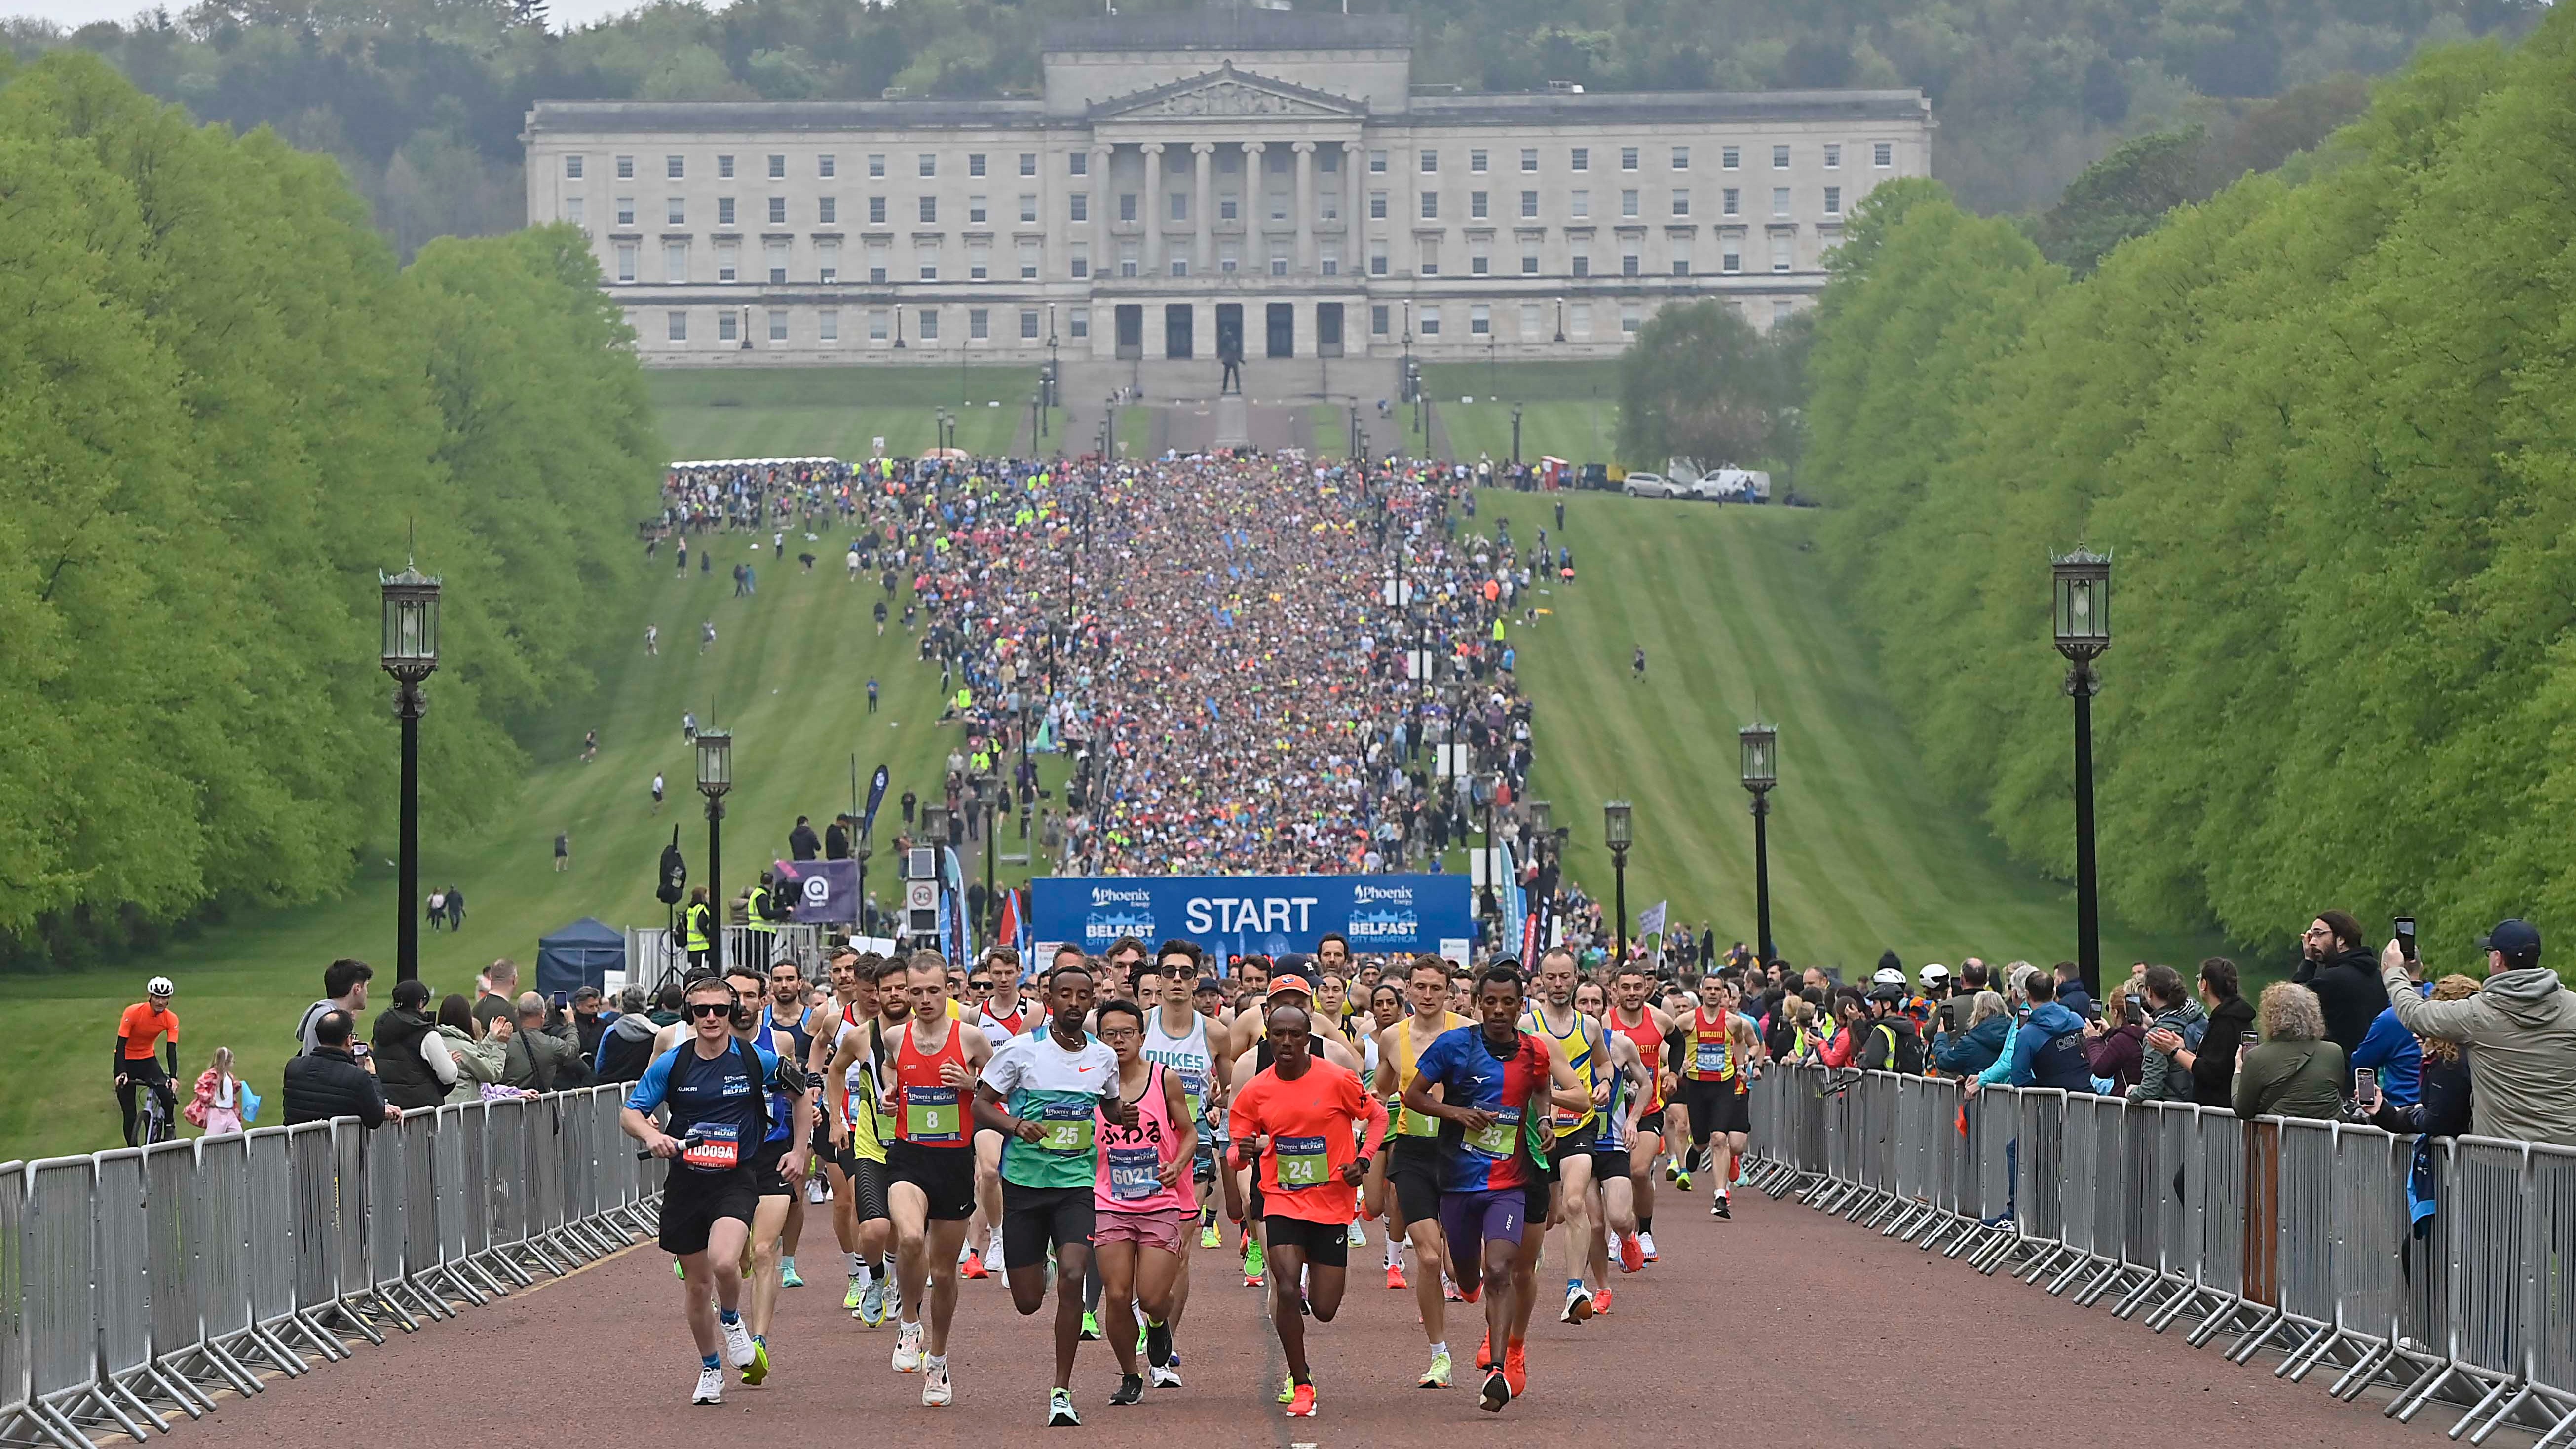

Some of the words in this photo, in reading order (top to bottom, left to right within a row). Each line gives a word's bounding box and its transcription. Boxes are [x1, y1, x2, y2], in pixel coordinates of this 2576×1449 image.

[1101, 888, 1150, 901] Phoenix
[1364, 885, 1413, 899] Phoenix
[1185, 897, 1318, 934] START
[1086, 924, 1156, 937] BELFAST
[1349, 922, 1418, 935] BELFAST
[1146, 1050, 1203, 1069] DUKES
[1698, 1054, 1723, 1065] 5536
[723, 1087, 750, 1095] BELFAST
[926, 1111, 938, 1128] 8
[1055, 1126, 1078, 1144] 25
[1478, 1127, 1503, 1146] 23
[1112, 1166, 1153, 1185] 6021
[1288, 1161, 1313, 1179] 24
